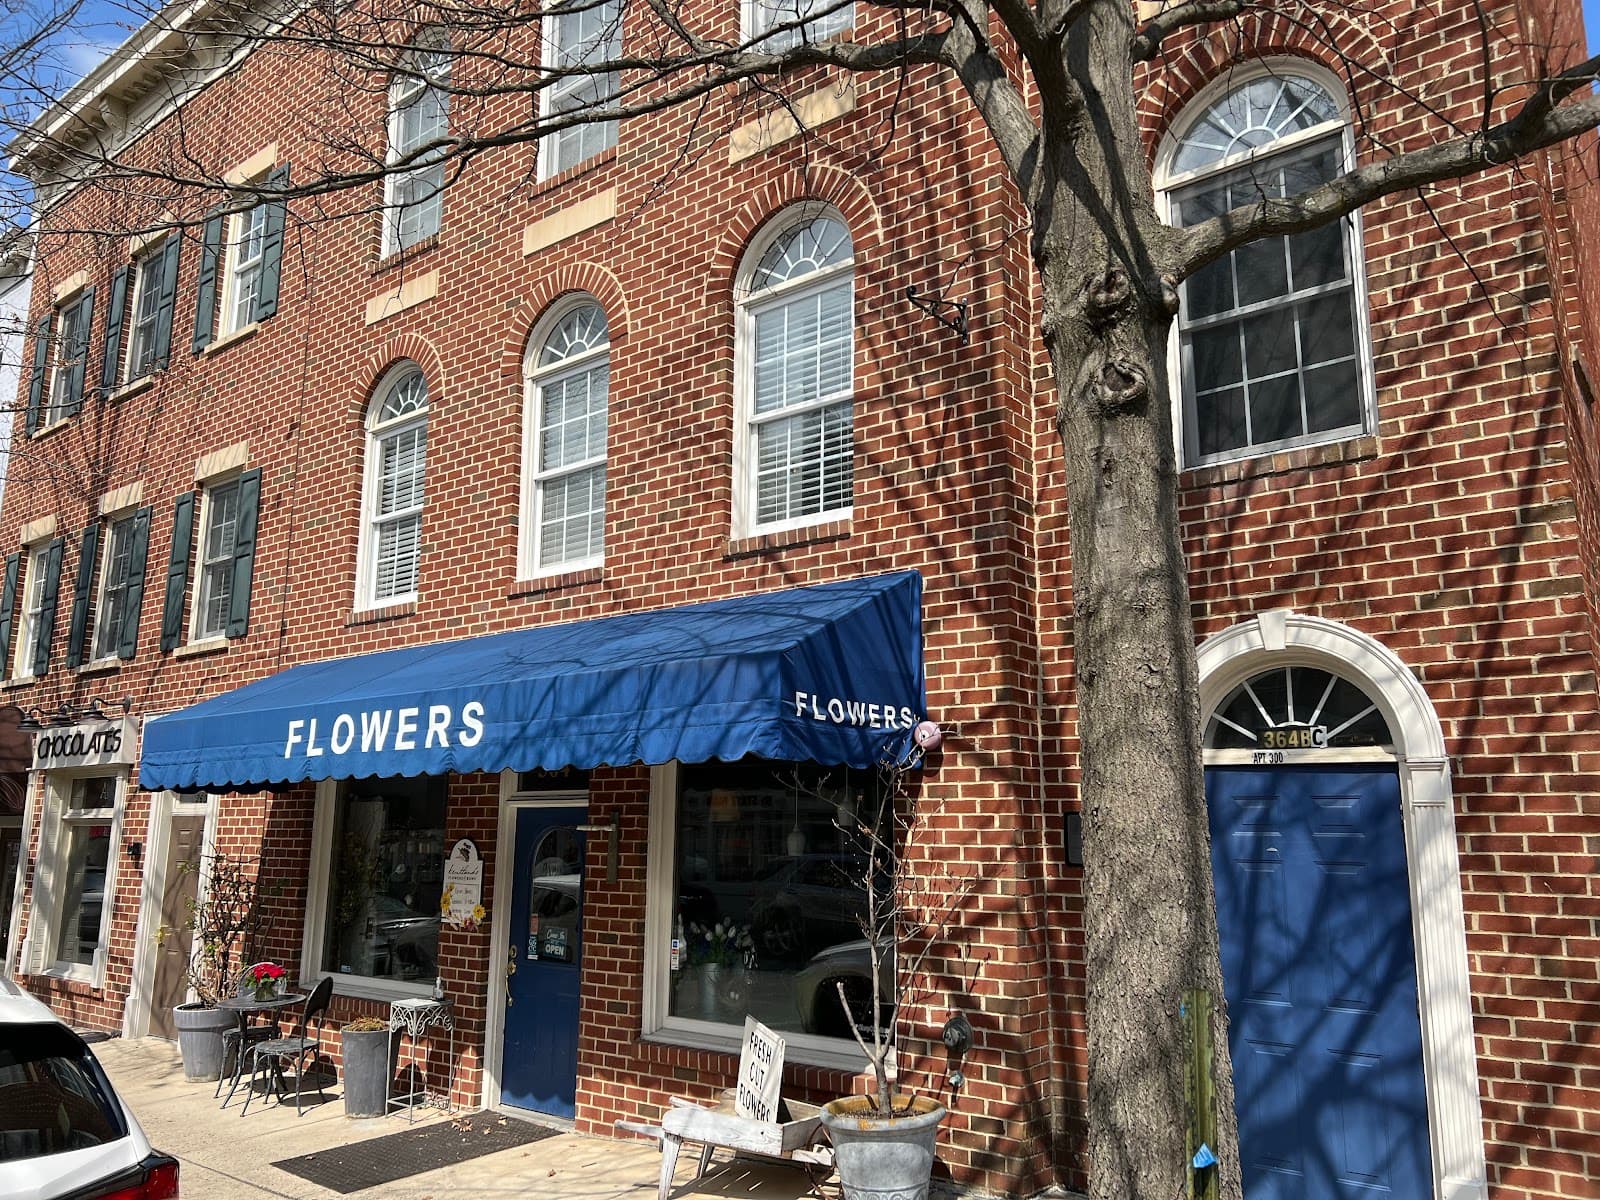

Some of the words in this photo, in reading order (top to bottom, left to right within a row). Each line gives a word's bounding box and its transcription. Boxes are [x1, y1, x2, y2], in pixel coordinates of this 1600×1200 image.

[795, 691, 913, 730] FLOWERS
[37, 728, 122, 759] CHOCOLATES
[284, 701, 485, 759] FLOWERS
[1268, 751, 1284, 763] 300
[545, 944, 565, 956] OPEN
[749, 1031, 772, 1065] FRESH
[749, 1062, 764, 1090] CUT
[739, 1083, 770, 1122] FLOWERS
